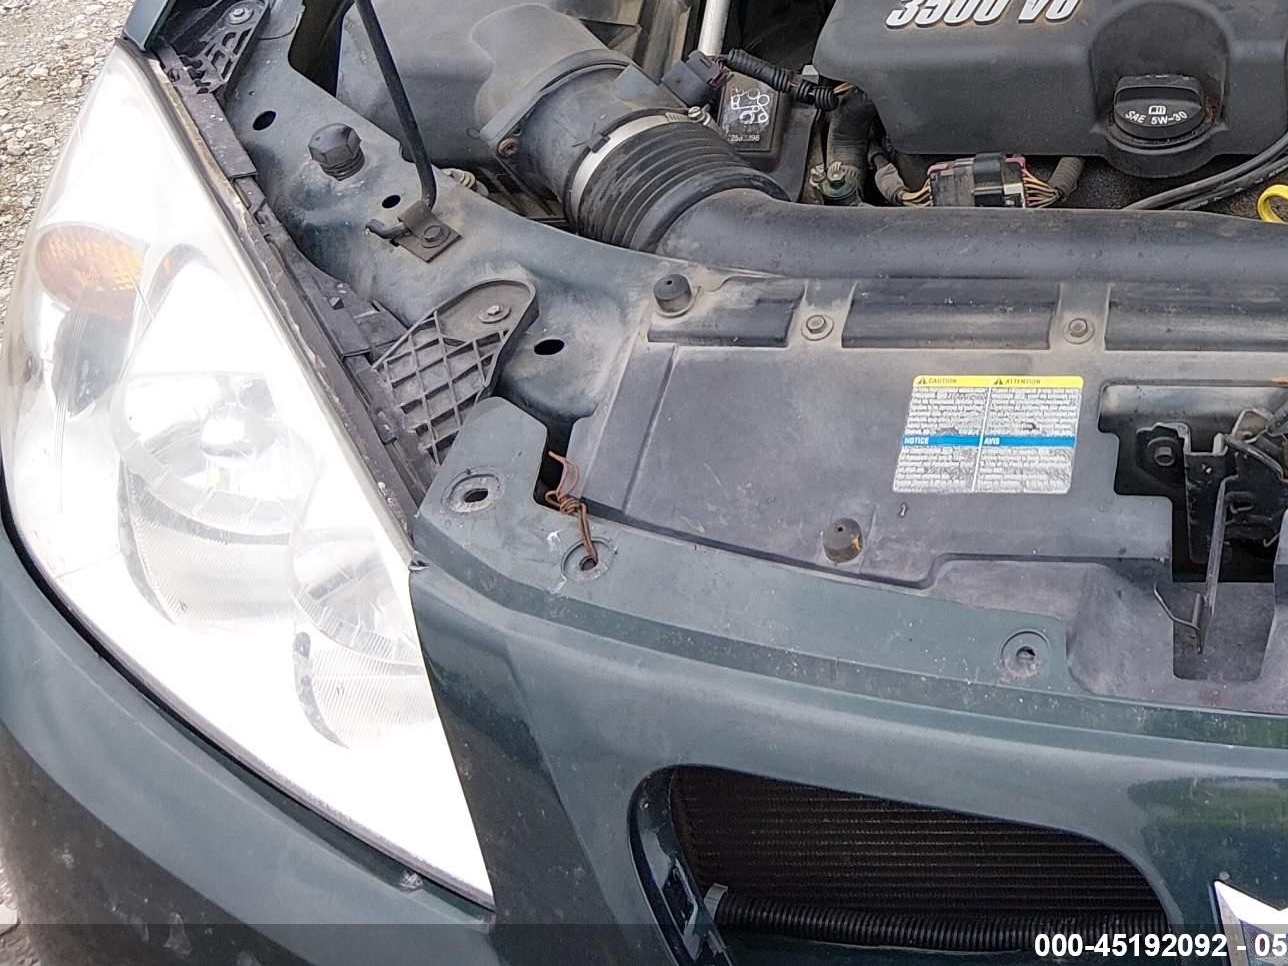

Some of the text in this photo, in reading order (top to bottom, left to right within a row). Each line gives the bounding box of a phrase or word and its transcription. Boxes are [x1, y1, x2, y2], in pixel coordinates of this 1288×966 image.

[1124, 110, 1188, 125] SAE 5W-30
[903, 437, 929, 445] NOTICE
[983, 437, 1000, 446] AVIS
